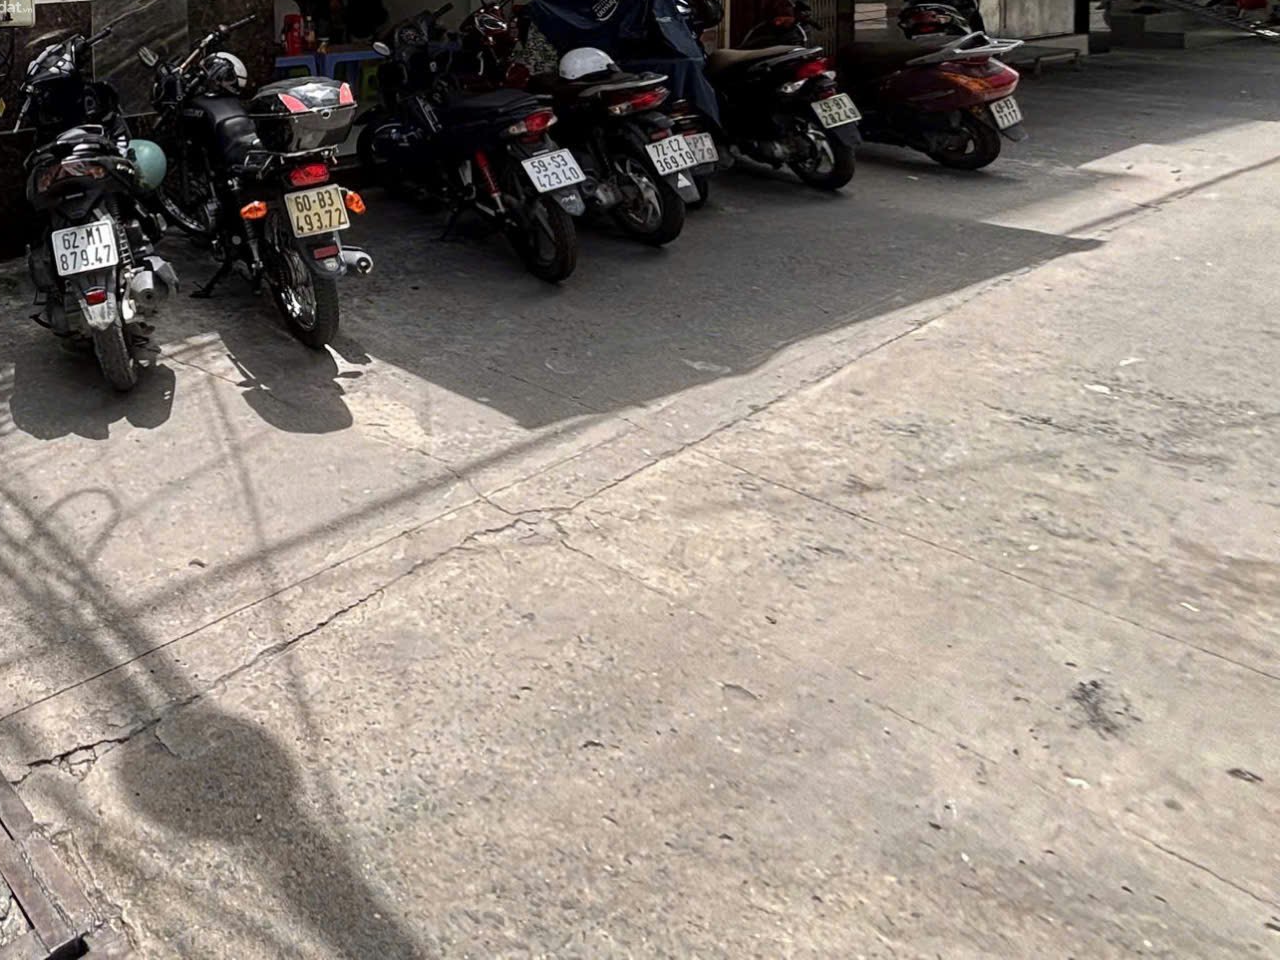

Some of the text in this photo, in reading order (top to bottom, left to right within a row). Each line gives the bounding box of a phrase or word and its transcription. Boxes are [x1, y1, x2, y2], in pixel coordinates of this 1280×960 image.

[652, 138, 683, 157] 72-C2
[531, 154, 568, 174] 59-S3
[656, 151, 694, 172] 369.19
[537, 167, 580, 188] 423.40
[294, 190, 334, 212] 60-B3
[296, 208, 348, 232] 493.72
[62, 226, 102, 250] 62-M1
[60, 245, 111, 271] 879.47
